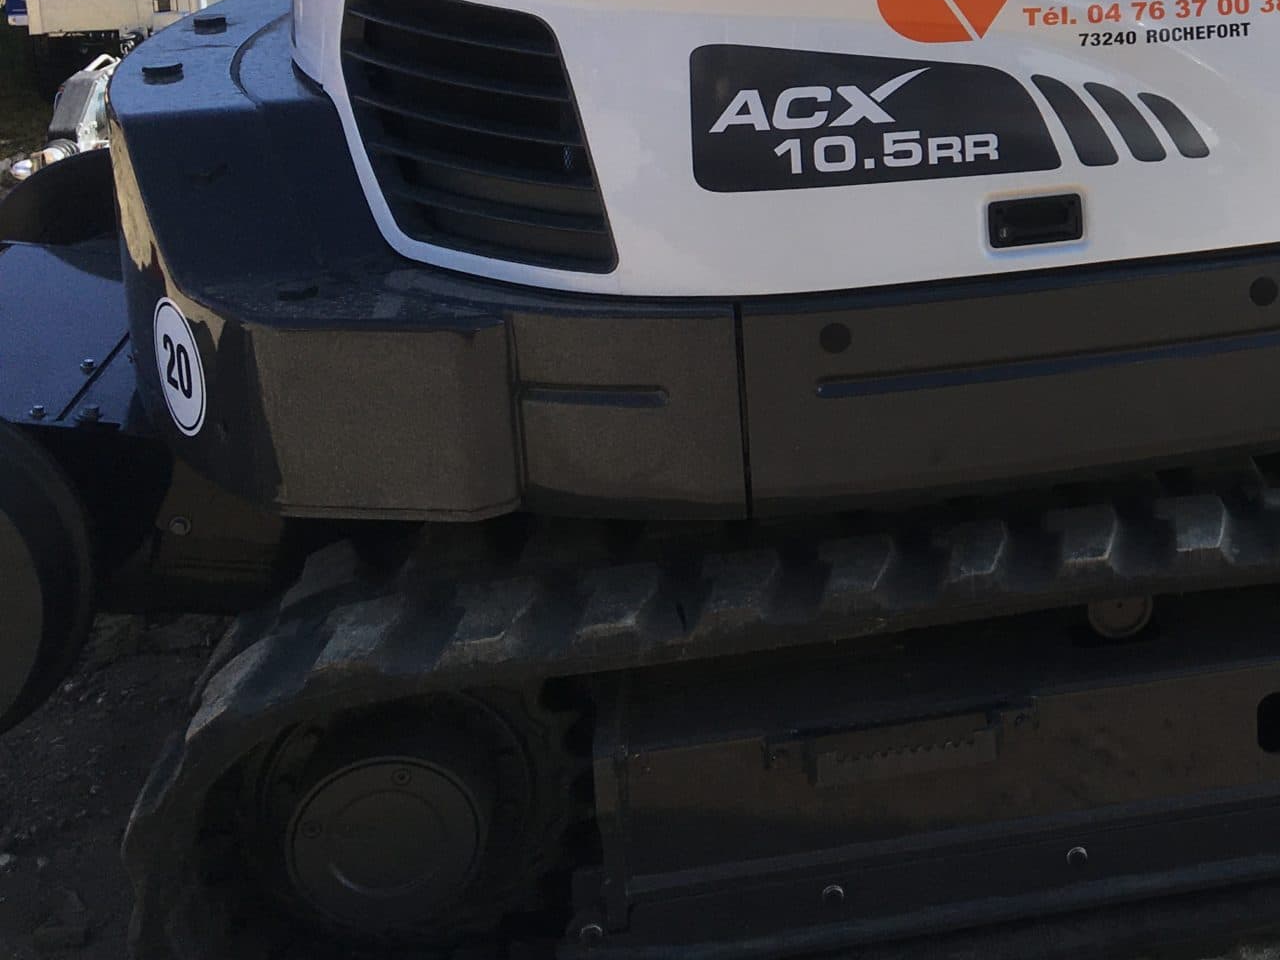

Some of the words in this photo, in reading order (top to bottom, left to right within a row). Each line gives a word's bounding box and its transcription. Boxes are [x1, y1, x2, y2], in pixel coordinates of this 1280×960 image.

[1022, 7, 1077, 27] Tél.
[1087, 3, 1121, 24] 04
[1131, 1, 1165, 21] 76
[1079, 31, 1137, 47] 73240
[1146, 22, 1251, 44] ROCHEFORT
[708, 67, 933, 134] ACX
[773, 130, 1000, 175] 10.5RR
[162, 333, 193, 400] 20
